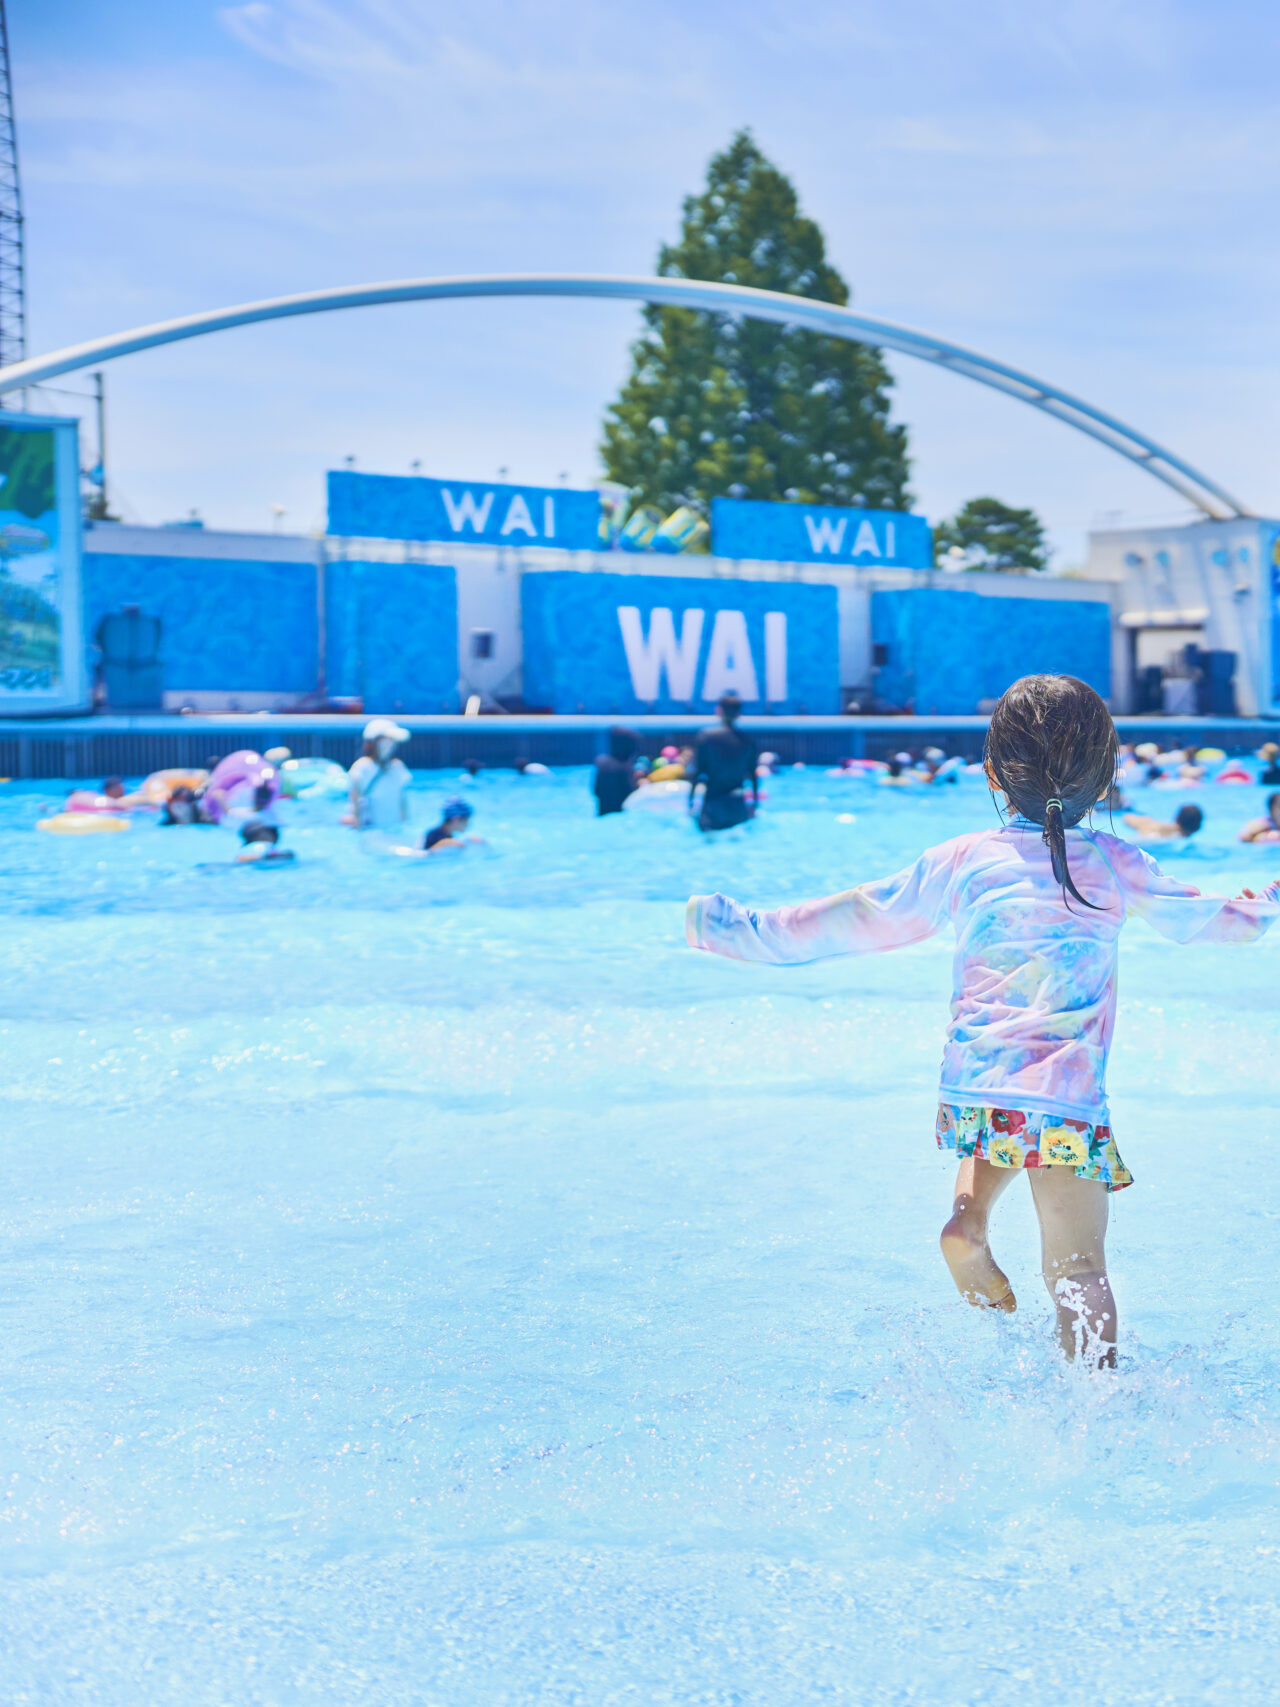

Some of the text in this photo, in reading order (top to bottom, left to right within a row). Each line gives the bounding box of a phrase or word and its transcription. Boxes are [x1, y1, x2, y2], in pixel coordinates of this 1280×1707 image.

[440, 488, 556, 539] WAI
[804, 515, 895, 559] WAI
[616, 605, 788, 702] WAI
